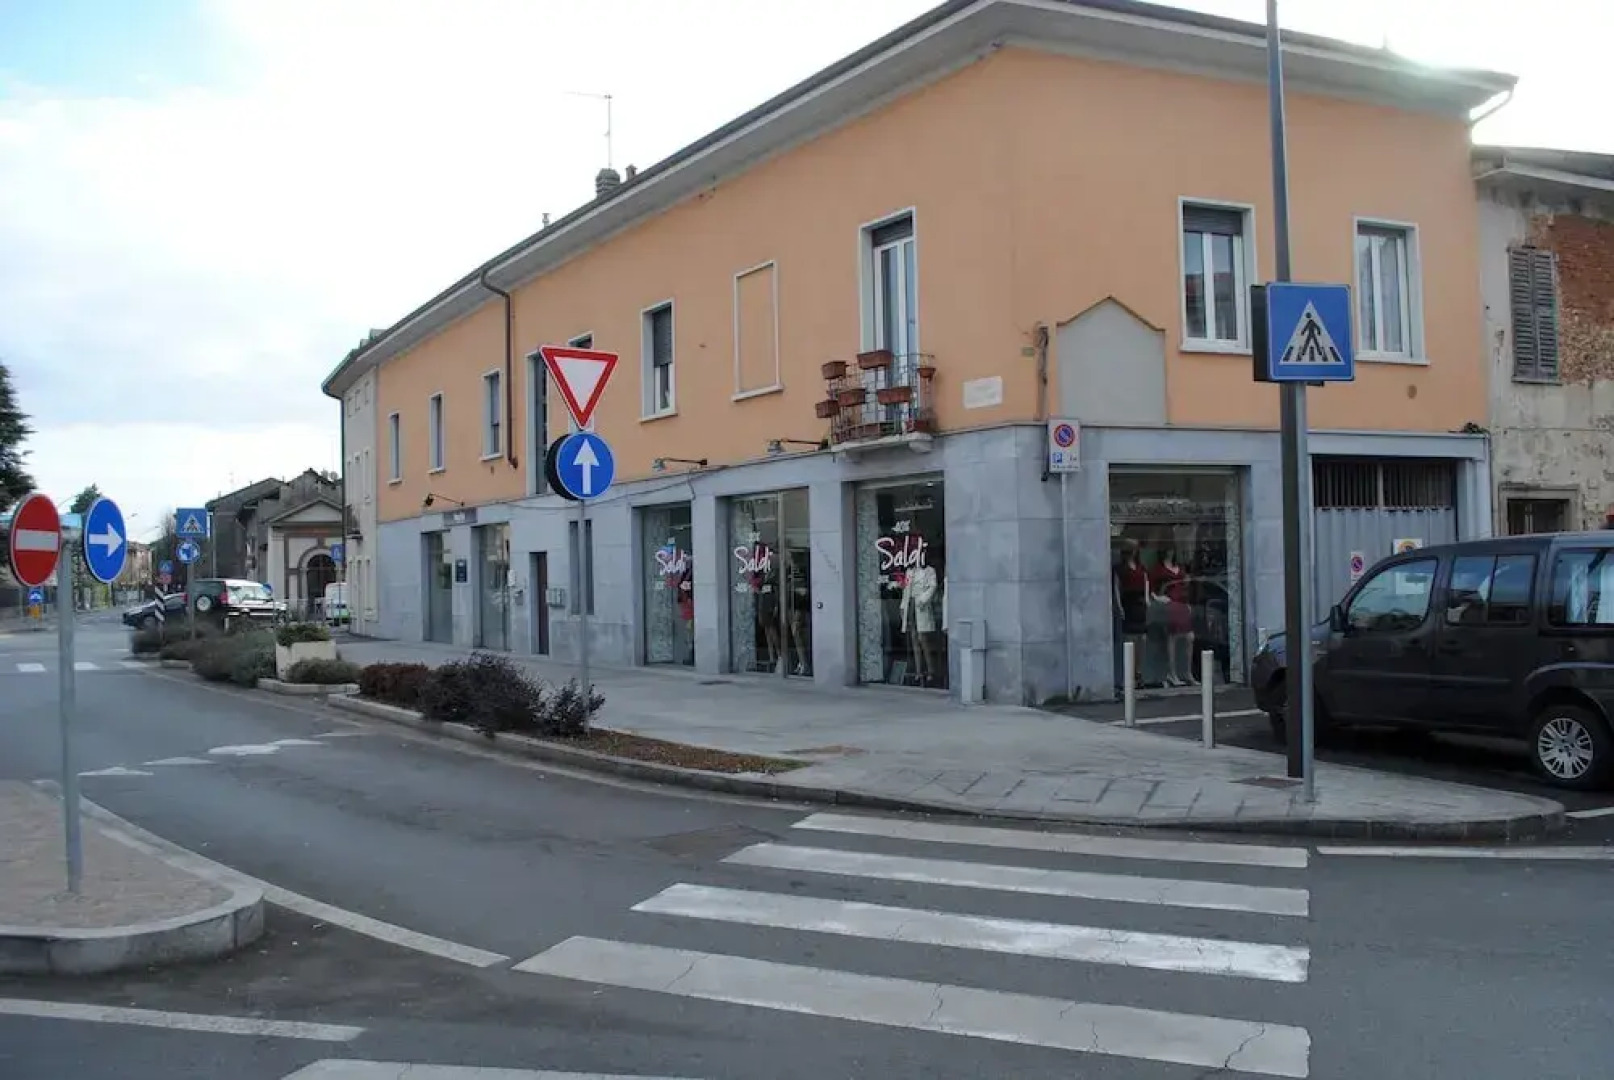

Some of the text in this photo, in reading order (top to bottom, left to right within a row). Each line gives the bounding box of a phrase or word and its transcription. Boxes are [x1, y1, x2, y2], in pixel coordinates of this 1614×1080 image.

[655, 549, 687, 575] Saldi
[734, 545, 773, 573] Saldi
[875, 535, 928, 570] Saldi
